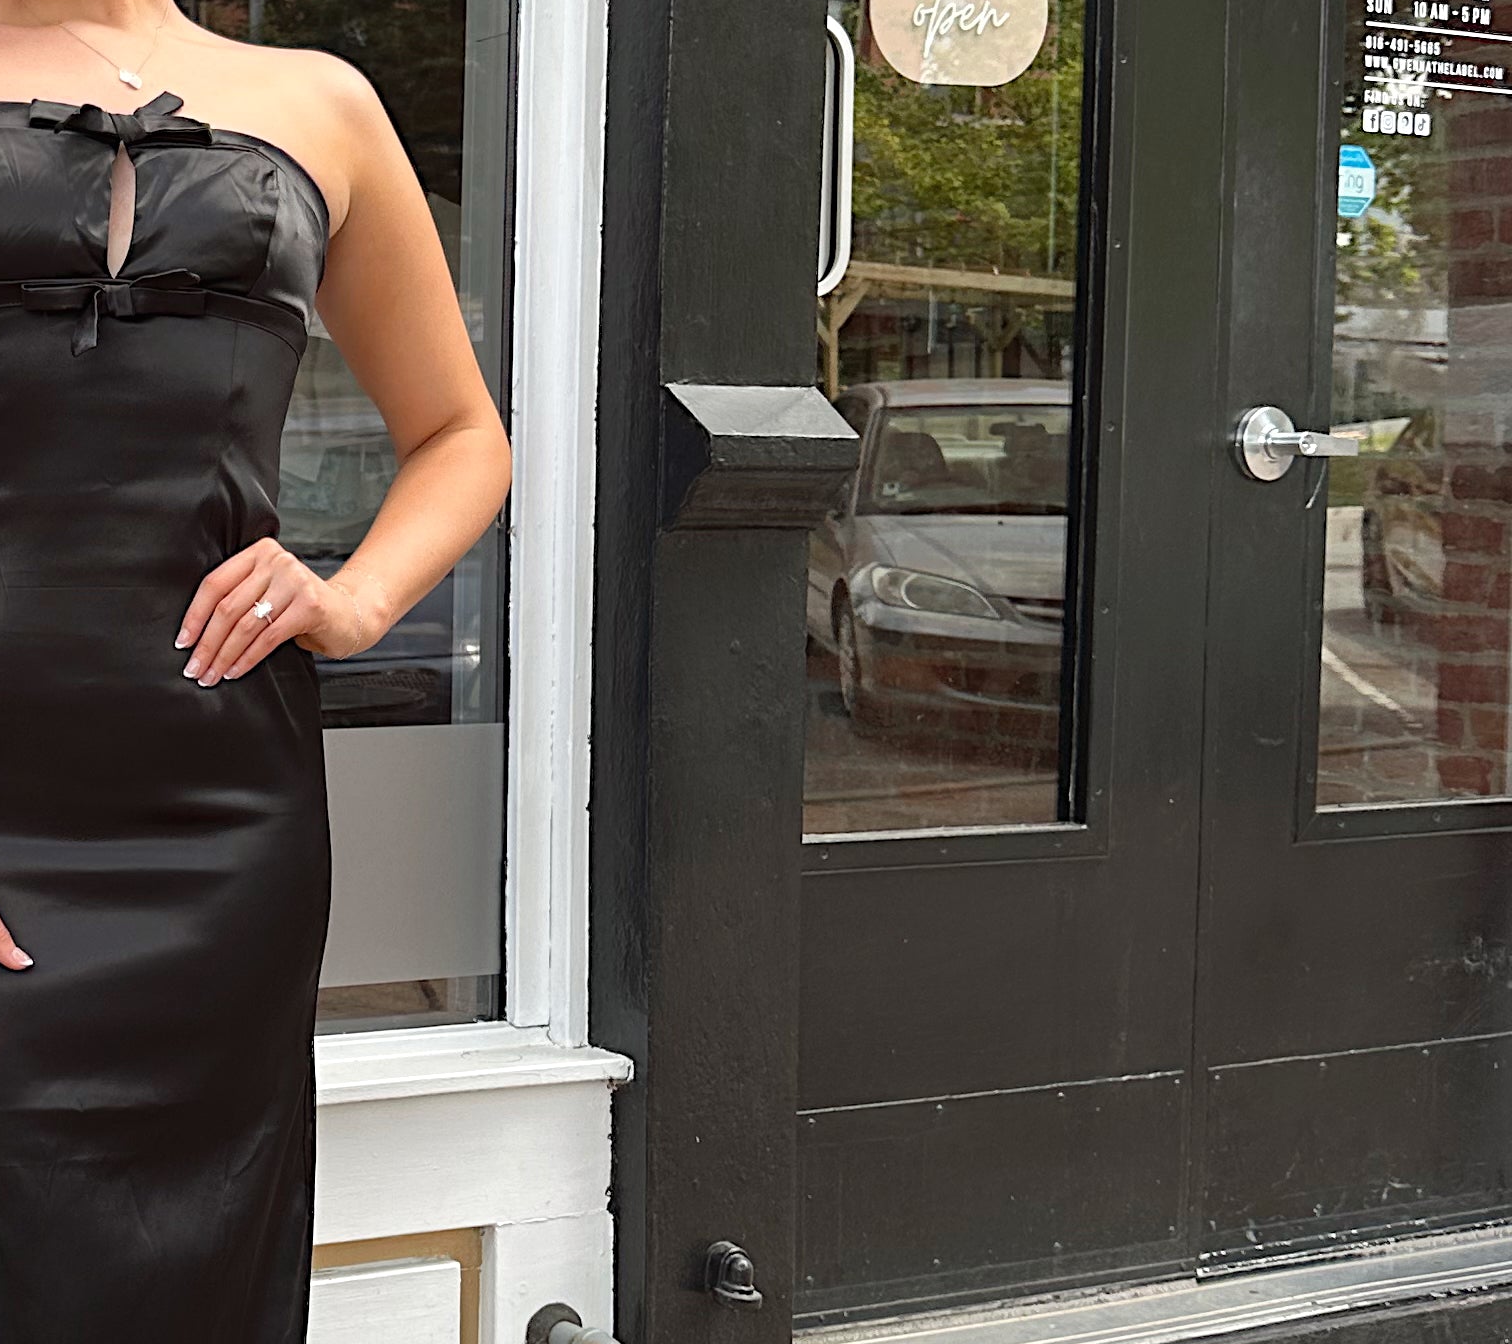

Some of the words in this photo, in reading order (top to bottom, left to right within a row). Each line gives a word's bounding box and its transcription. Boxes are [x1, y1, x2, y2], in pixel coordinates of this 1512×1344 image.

[1414, 0, 1427, 17] 10
[1430, 2, 1448, 20] AM
[1462, 6, 1469, 23] 5
[1472, 8, 1490, 24] PM
